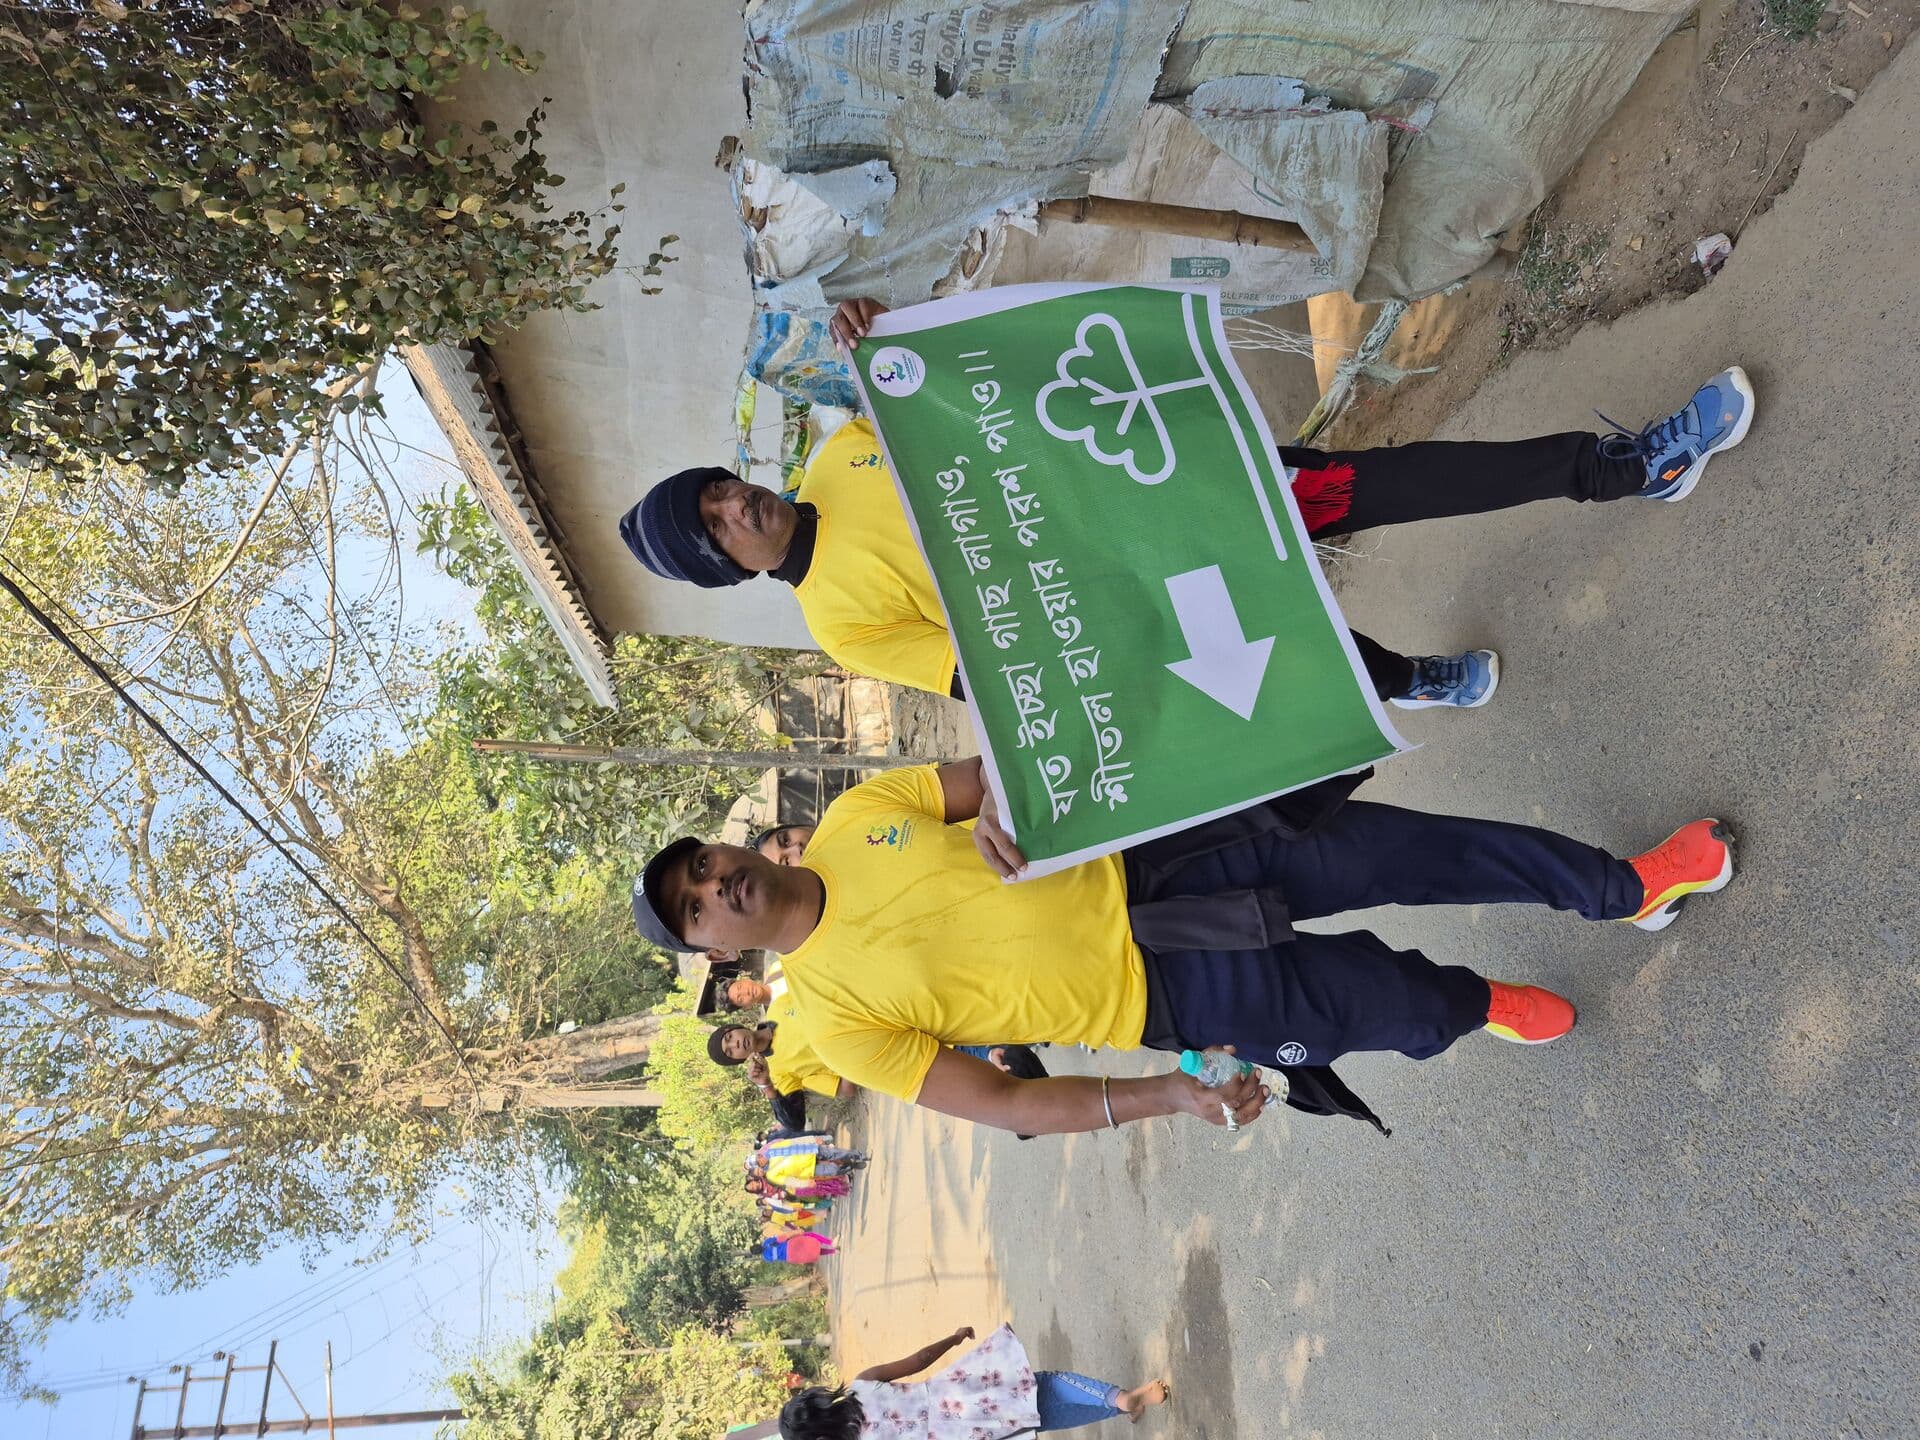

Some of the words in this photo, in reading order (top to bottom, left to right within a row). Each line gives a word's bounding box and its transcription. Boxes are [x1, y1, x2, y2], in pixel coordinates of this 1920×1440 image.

[936, 455, 993, 577] লাগাও,
[991, 463, 1045, 548] পরশ
[975, 578, 1022, 650] গাছ
[1027, 558, 1101, 687] হাওয়ার
[998, 661, 1059, 749] ইচ্ছা
[1036, 755, 1079, 824] যত
[1079, 691, 1135, 812] শীতল
